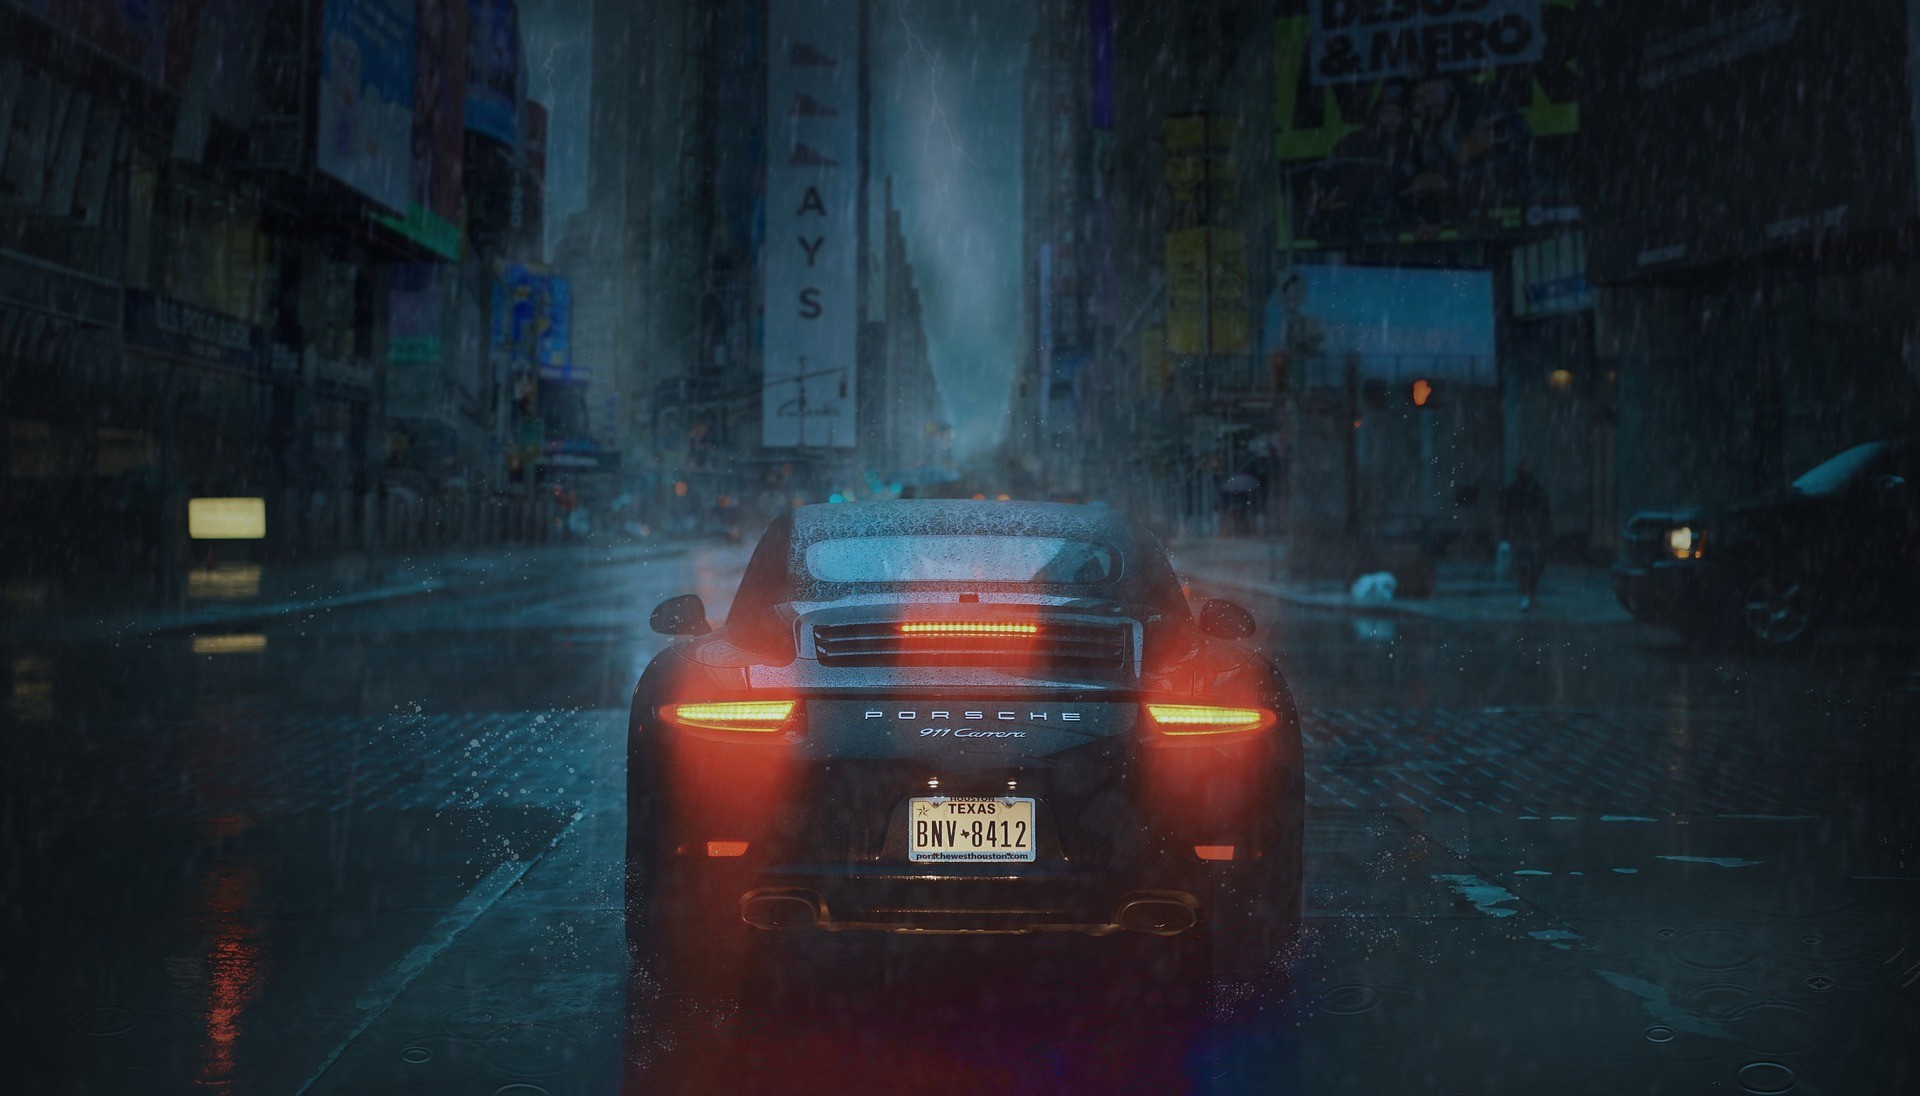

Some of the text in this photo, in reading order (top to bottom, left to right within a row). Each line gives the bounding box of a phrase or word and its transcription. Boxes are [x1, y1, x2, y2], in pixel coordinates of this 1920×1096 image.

[1315, 13, 1533, 76] & MERO
[865, 711, 1081, 721] PORSCHE
[920, 728, 1027, 738] 911 Carrera
[948, 803, 996, 814] TEXAS
[916, 852, 1028, 860] porschewesthouston.com
